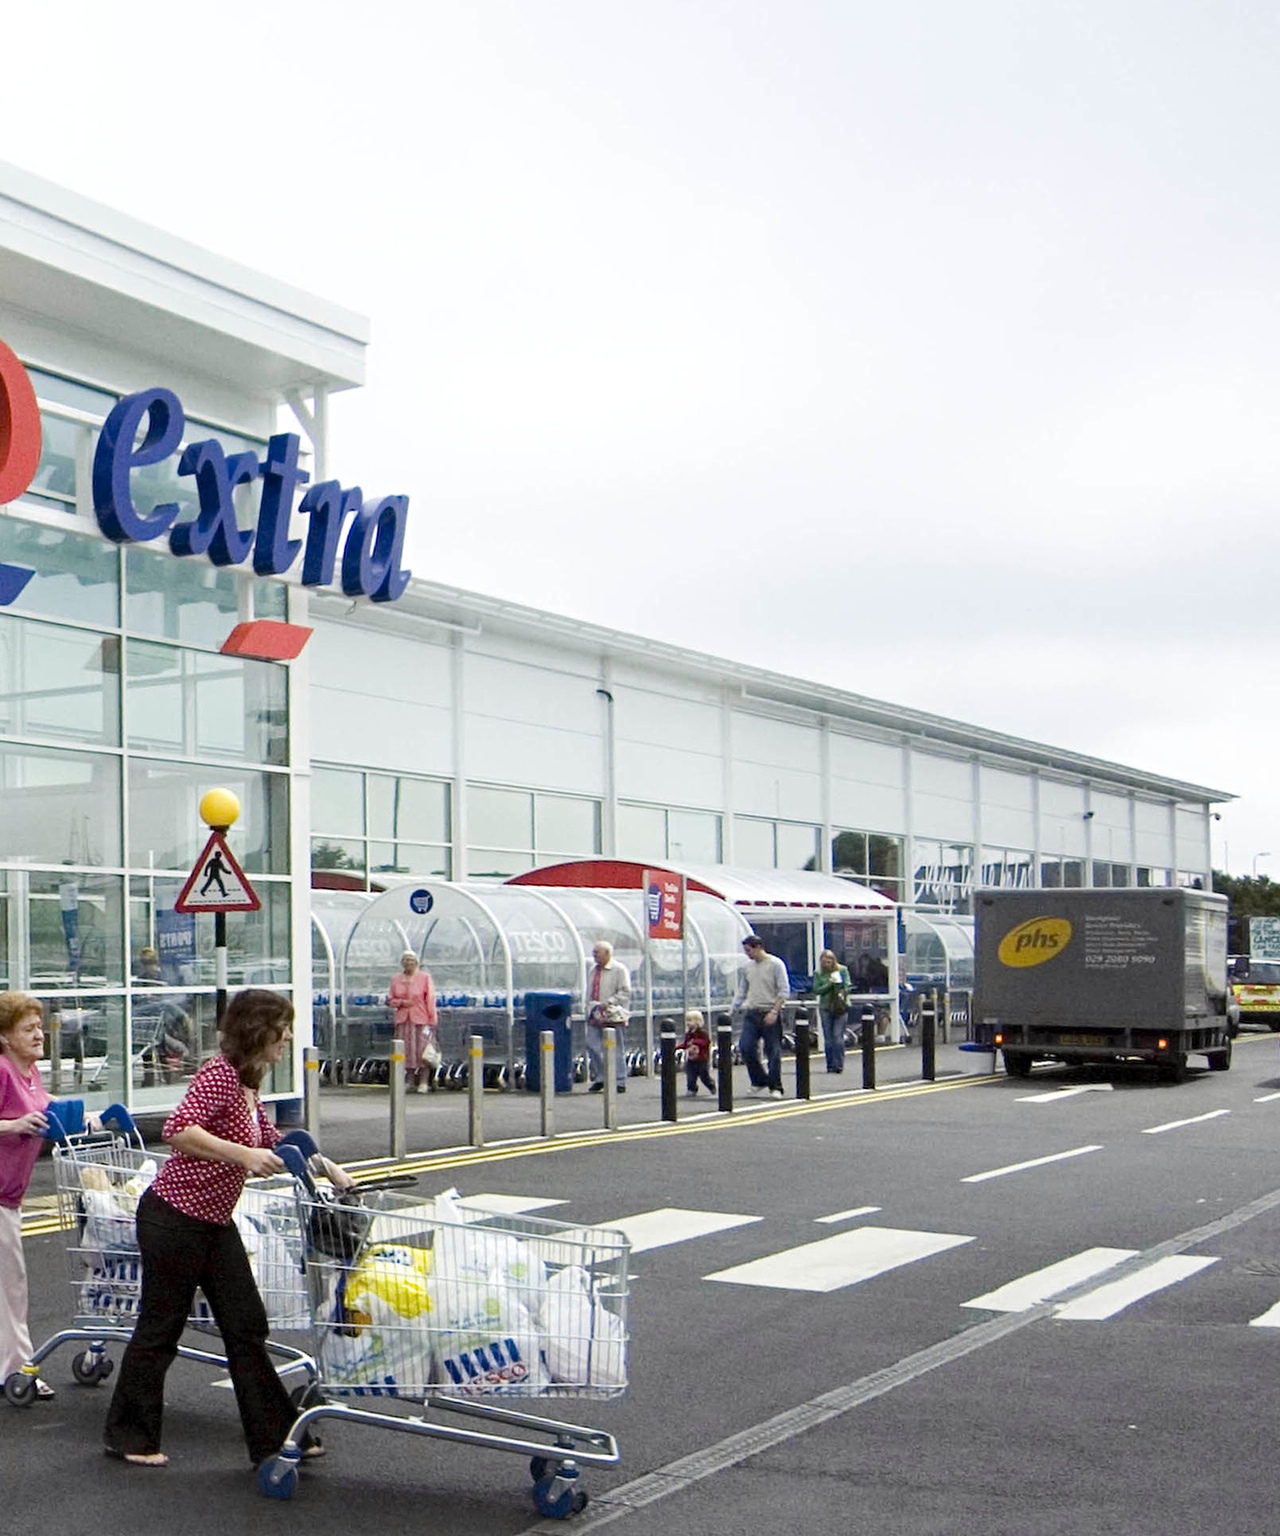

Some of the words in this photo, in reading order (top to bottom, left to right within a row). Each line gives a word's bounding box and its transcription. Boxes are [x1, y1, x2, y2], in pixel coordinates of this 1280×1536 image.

[92, 387, 412, 603] extra
[509, 931, 566, 952] TESCO
[1015, 927, 1060, 953] phs
